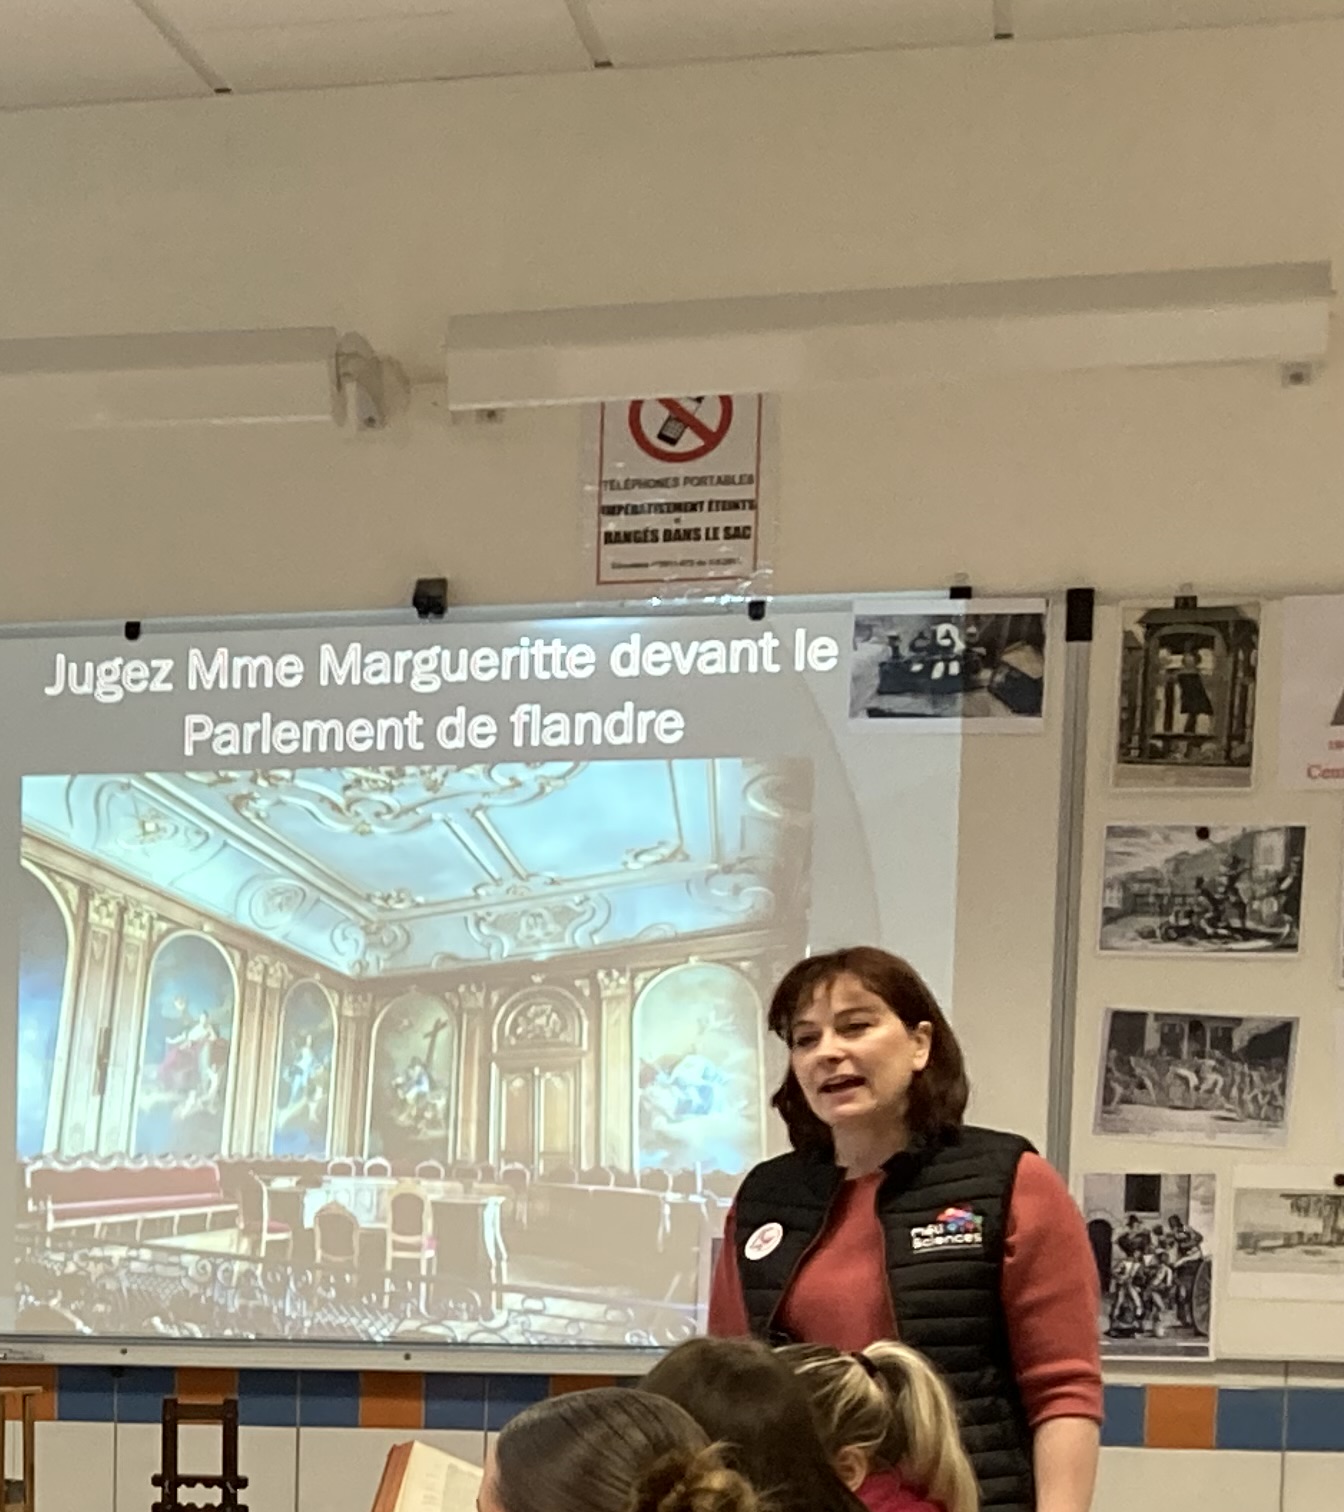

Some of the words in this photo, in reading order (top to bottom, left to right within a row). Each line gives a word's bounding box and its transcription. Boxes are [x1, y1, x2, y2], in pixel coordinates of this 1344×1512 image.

[604, 526, 659, 545] RANGÉS
[663, 527, 701, 543] DANS
[705, 526, 720, 541] LE
[723, 525, 752, 540] SAC
[43, 652, 175, 704] Jugez
[188, 646, 305, 691] Mme
[318, 636, 597, 694] Margueritte
[610, 632, 781, 678] devant
[793, 628, 840, 673] le
[183, 709, 425, 757] Parlement
[436, 705, 499, 750] de
[509, 700, 686, 748] flandre
